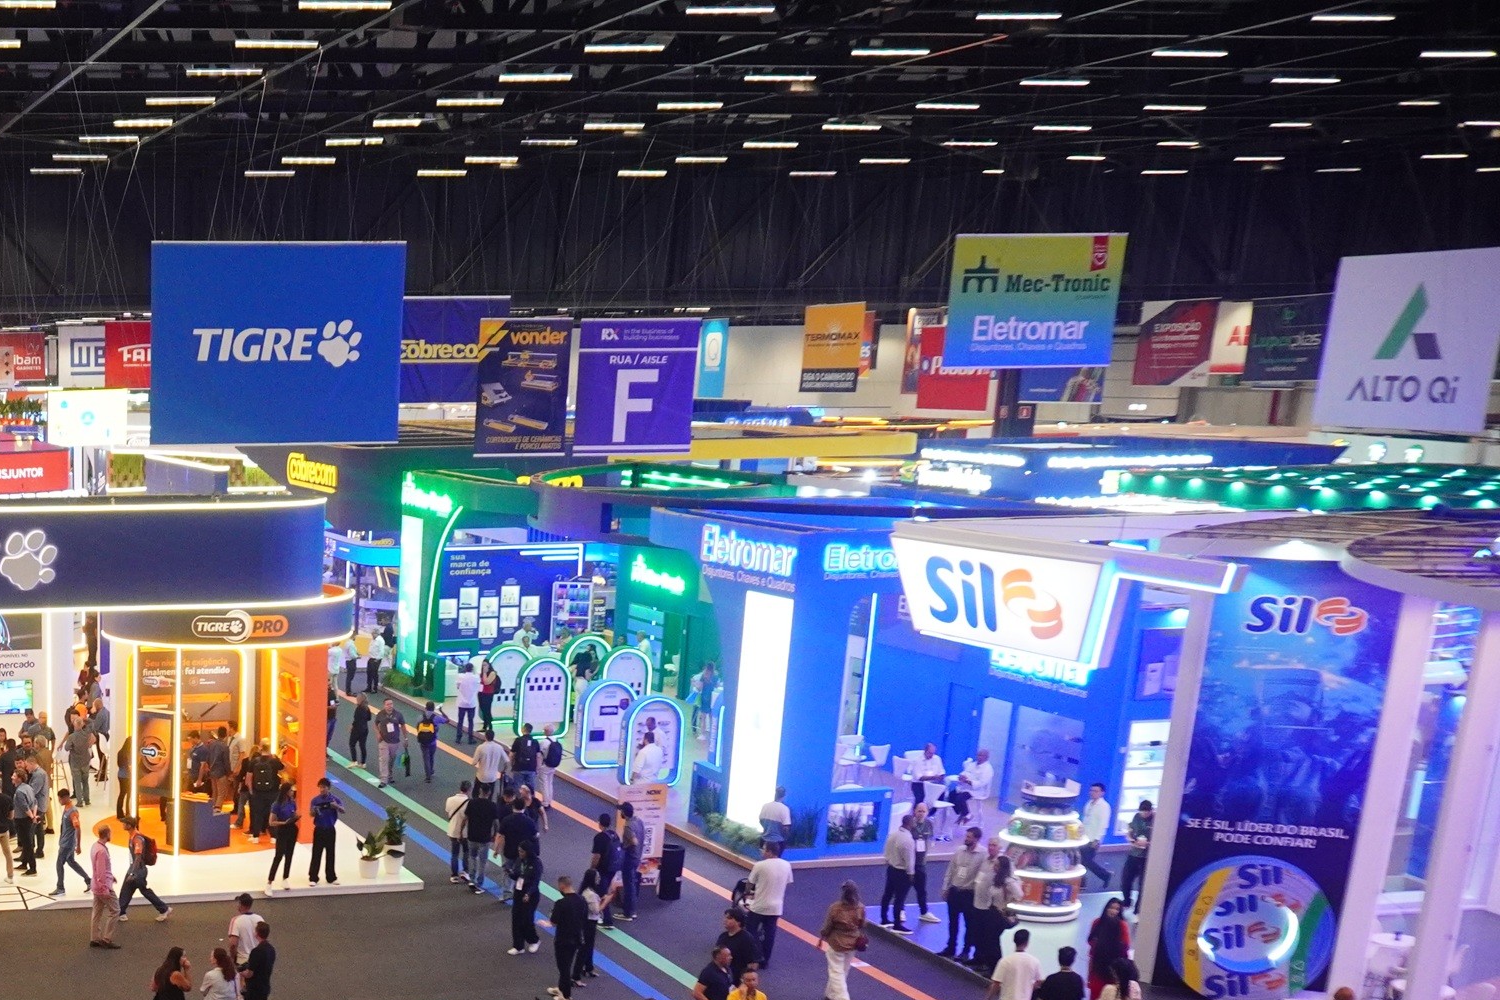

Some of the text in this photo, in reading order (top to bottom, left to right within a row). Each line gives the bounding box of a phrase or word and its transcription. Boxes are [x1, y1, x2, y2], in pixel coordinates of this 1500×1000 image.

[1005, 273, 1112, 293] Mec-Tronic
[510, 329, 567, 346] vonder
[805, 331, 861, 343] TERMOMAX
[971, 315, 1090, 341] Eletromar
[193, 327, 316, 363] TIGRE
[610, 355, 631, 365] RUA
[641, 355, 668, 364] AISLE
[1347, 375, 1459, 404] ALTO Qi
[612, 369, 660, 443] F
[701, 524, 797, 577] Eletromar
[450, 568, 491, 576] confiança
[925, 556, 997, 632] Sil
[196, 619, 285, 634] TIGRE PRO
[1244, 596, 1317, 635] Sil
[143, 666, 231, 676] finalmen foi atendido
[1186, 818, 1201, 828] SE
[1203, 817, 1211, 829] É
[1236, 820, 1274, 833] LÍDER
[1275, 824, 1298, 835] DO
[1214, 832, 1317, 849] PODE CONFIAR!
[1237, 864, 1283, 889] Sil
[1203, 924, 1245, 951] Sil
[1204, 972, 1250, 999] Sil
